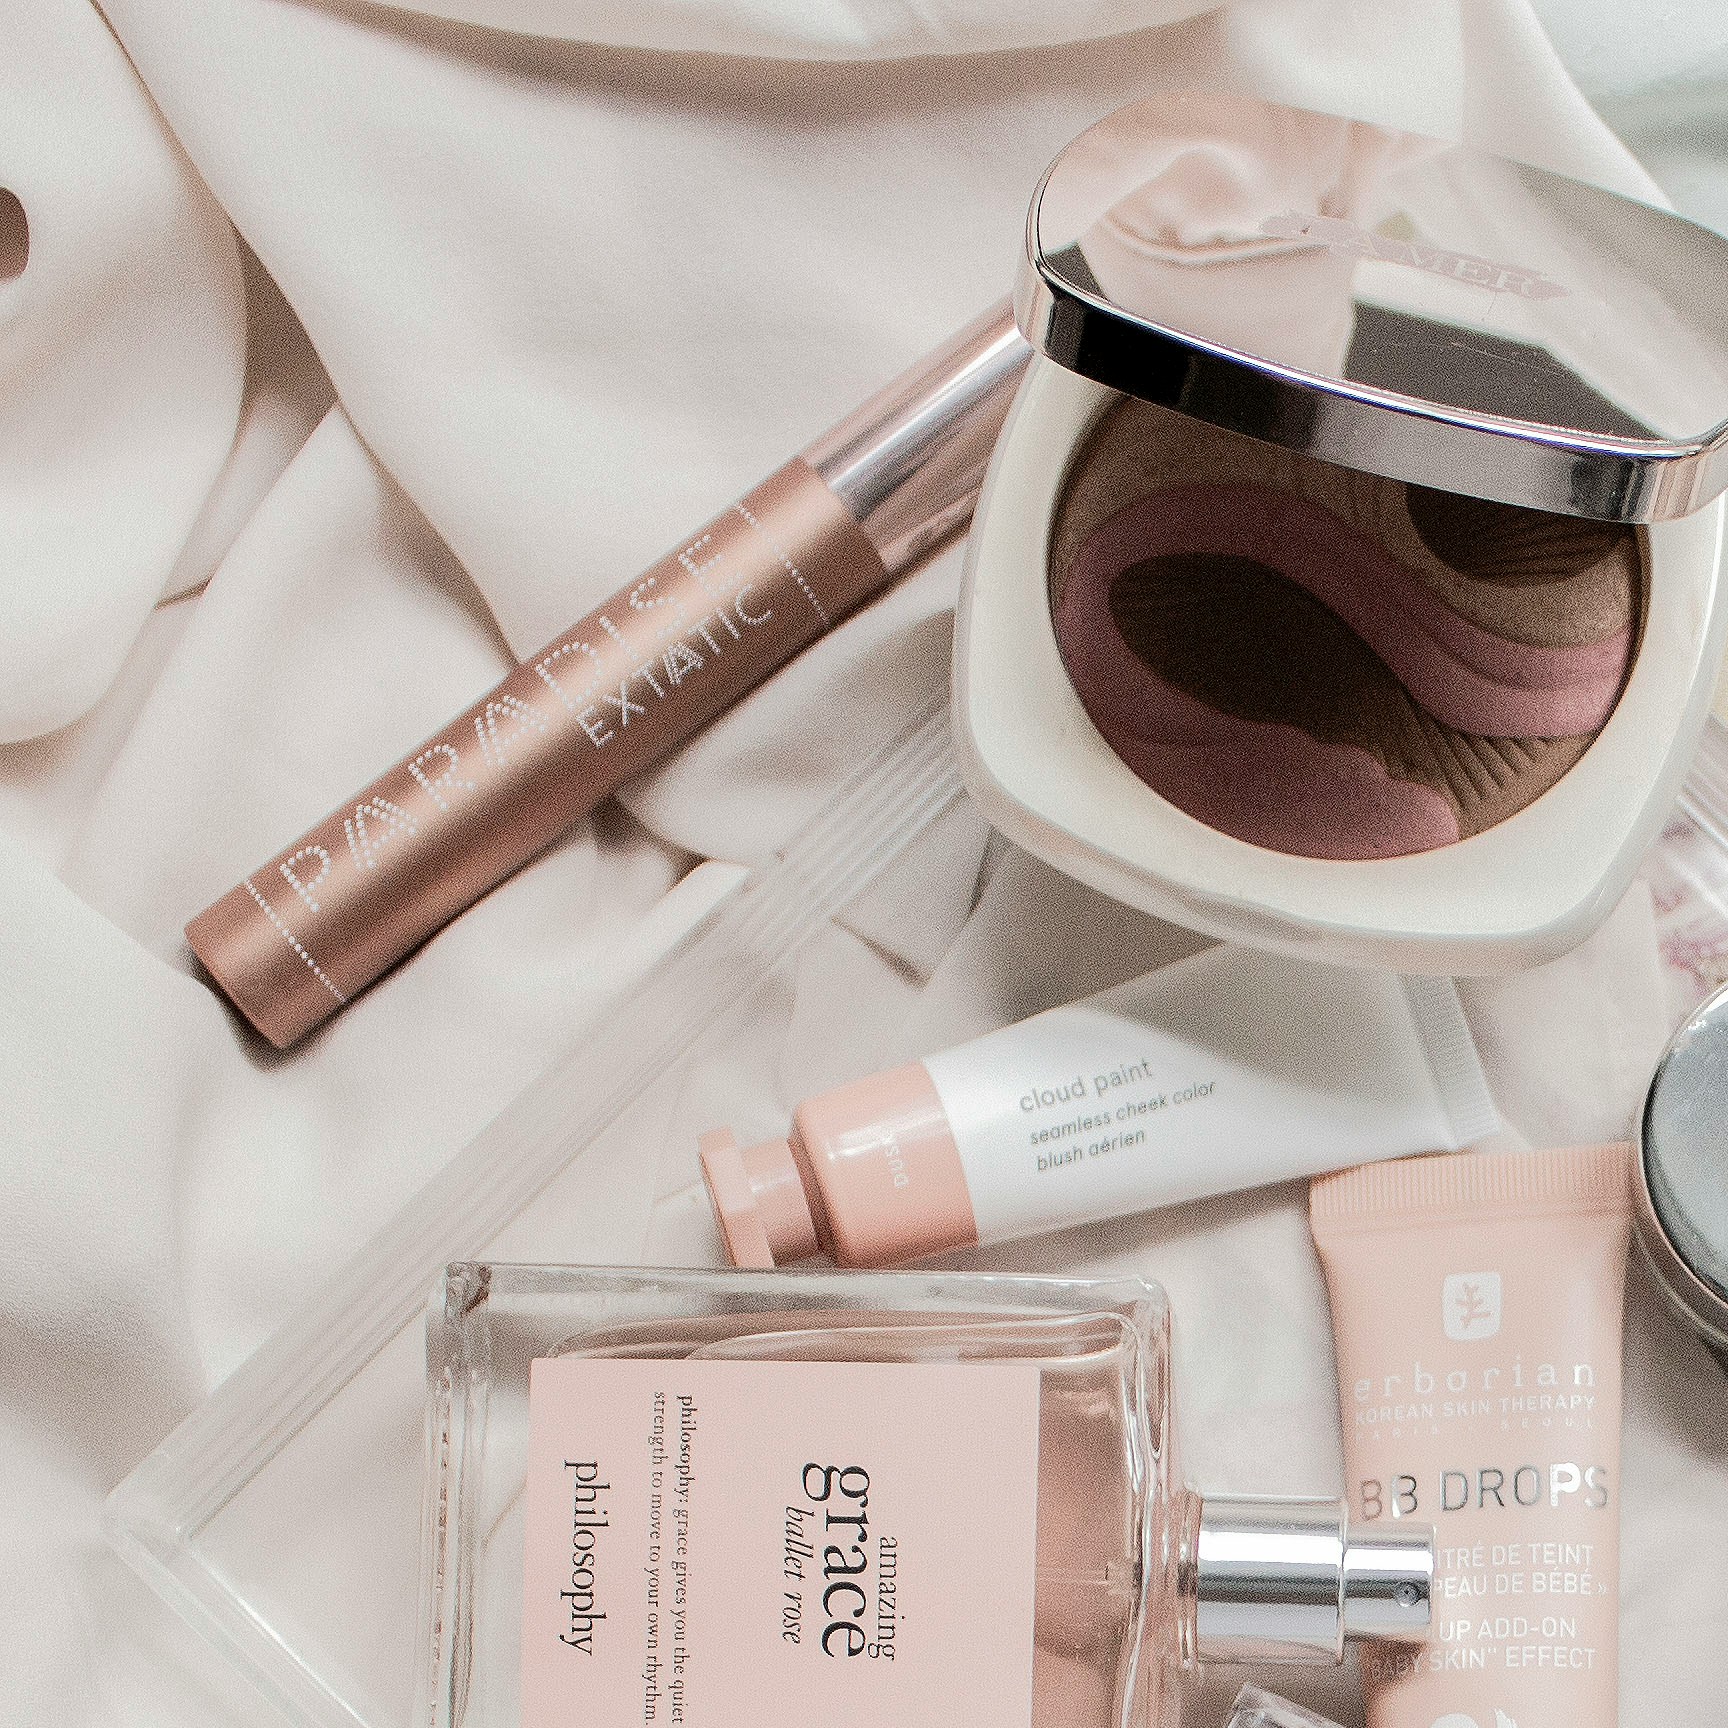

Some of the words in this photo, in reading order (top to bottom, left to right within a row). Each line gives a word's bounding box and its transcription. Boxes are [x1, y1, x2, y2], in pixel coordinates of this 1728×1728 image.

[1397, 243, 1535, 298] MER
[576, 584, 773, 747] EXTATIC
[279, 534, 743, 914] PARADISE
[1019, 1076, 1086, 1112] cloud
[1093, 1058, 1152, 1097] paint
[1030, 1110, 1111, 1145] seamless
[1115, 1094, 1168, 1121] cheek
[1172, 1080, 1216, 1105] color
[1037, 1146, 1083, 1172] blush
[1088, 1129, 1146, 1158] aérien
[1355, 1355, 1595, 1400] erborian
[647, 1391, 668, 1465] strength
[1356, 1403, 1434, 1425] KOREAN
[1443, 1399, 1491, 1418] SKIN
[1500, 1395, 1595, 1414] THERAPY
[674, 1393, 698, 1503] philosophy:
[651, 1470, 663, 1489] to
[1359, 1474, 1418, 1521] BB
[1440, 1462, 1609, 1512] DROPS
[649, 1494, 663, 1539] move
[672, 1508, 689, 1554] grace
[559, 1459, 611, 1657] philosophy
[648, 1544, 661, 1563] to
[784, 1505, 816, 1581] ballet
[802, 1462, 870, 1658] grace
[1491, 1545, 1521, 1567] DE
[1528, 1543, 1594, 1567] TEINT
[643, 1567, 660, 1608] your
[671, 1559, 692, 1605] gives
[868, 1536, 906, 1661] amazing
[1495, 1572, 1524, 1594] DE
[1532, 1566, 1593, 1595] BÉBÉ
[646, 1612, 659, 1650] own
[669, 1607, 687, 1642] you
[781, 1591, 803, 1645] rose
[1477, 1616, 1577, 1640] ADD-ON
[672, 1645, 690, 1675] the
[1505, 1646, 1596, 1670] EFFECT
[641, 1655, 663, 1726] rhythm.
[668, 1677, 689, 1724] quiet
